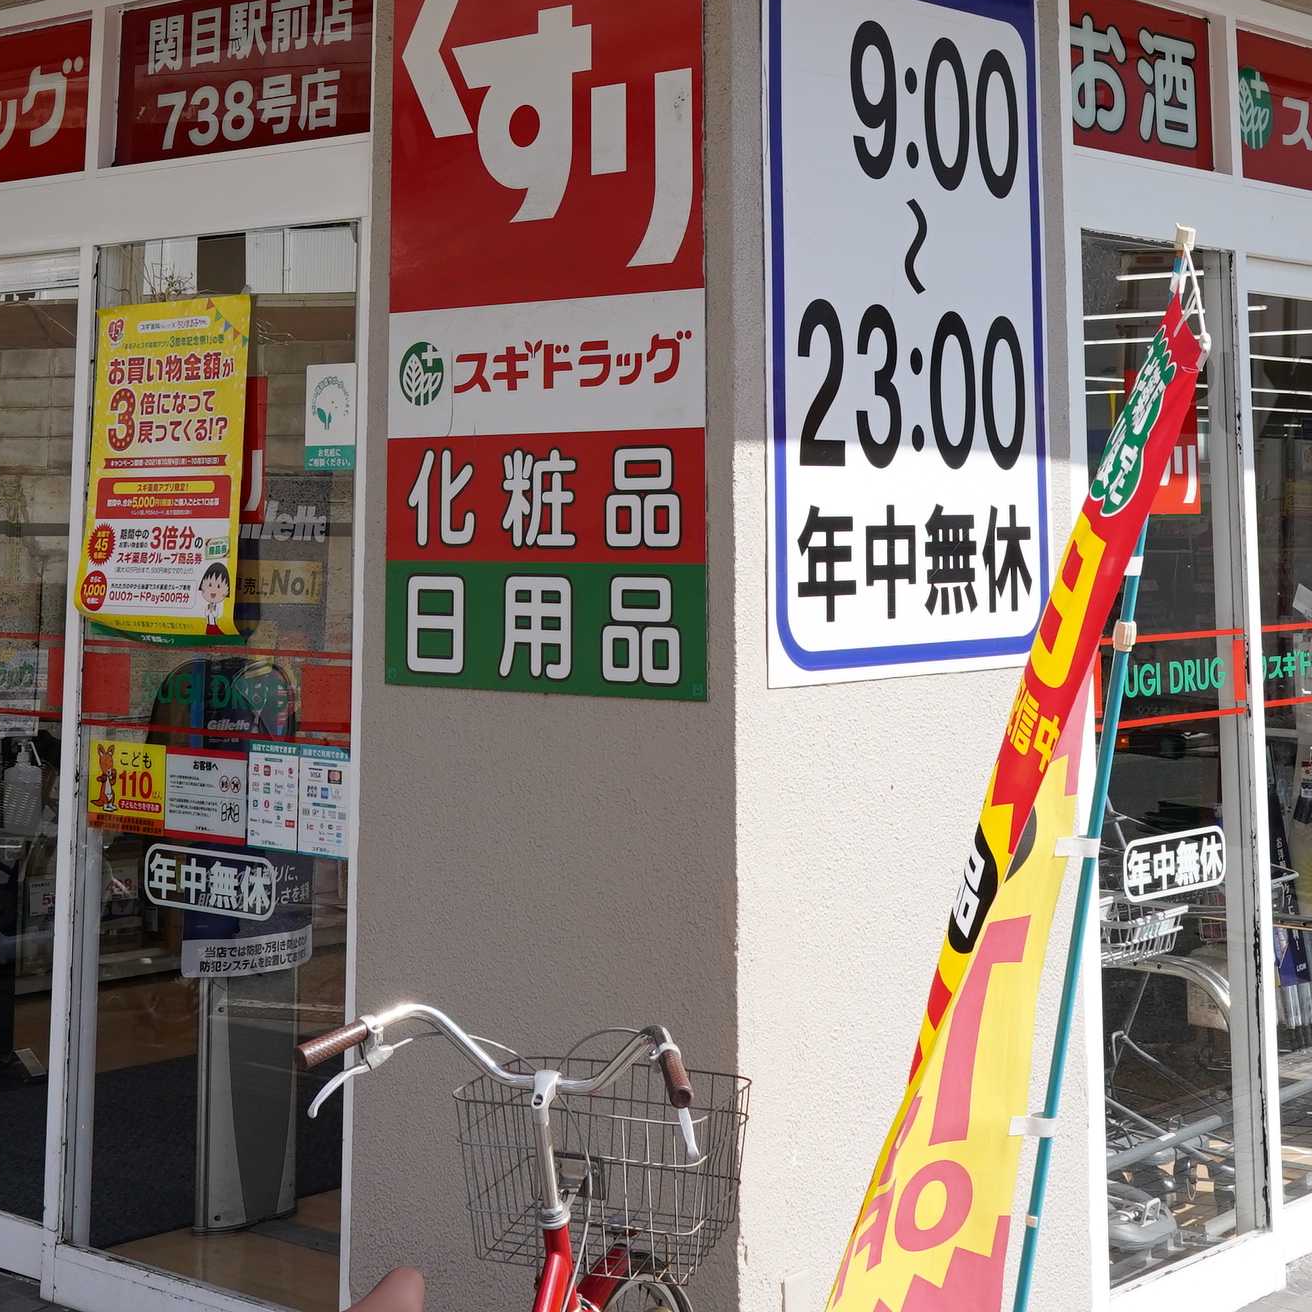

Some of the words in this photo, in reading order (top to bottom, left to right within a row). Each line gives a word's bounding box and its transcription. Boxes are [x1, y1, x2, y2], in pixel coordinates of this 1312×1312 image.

[158, 68, 339, 151] 738号店
[850, 20, 1020, 200] 9:00
[1070, 14, 1198, 150] お酒
[108, 352, 234, 385] お買い物金額が
[453, 330, 692, 393] スギドラッグ
[797, 299, 1027, 471] 23:00
[108, 388, 135, 451] 3
[140, 391, 215, 416] 倍になって
[408, 445, 681, 550] 化粧品
[797, 503, 1033, 622] 年中無休
[406, 574, 681, 687] 日用品
[1125, 661, 1162, 699] UGI
[1169, 659, 1227, 693] DRUG
[119, 771, 153, 800] 110
[120, 752, 153, 769] こども
[150, 853, 271, 915] 年中無休
[1128, 836, 1223, 895] 年中無休
